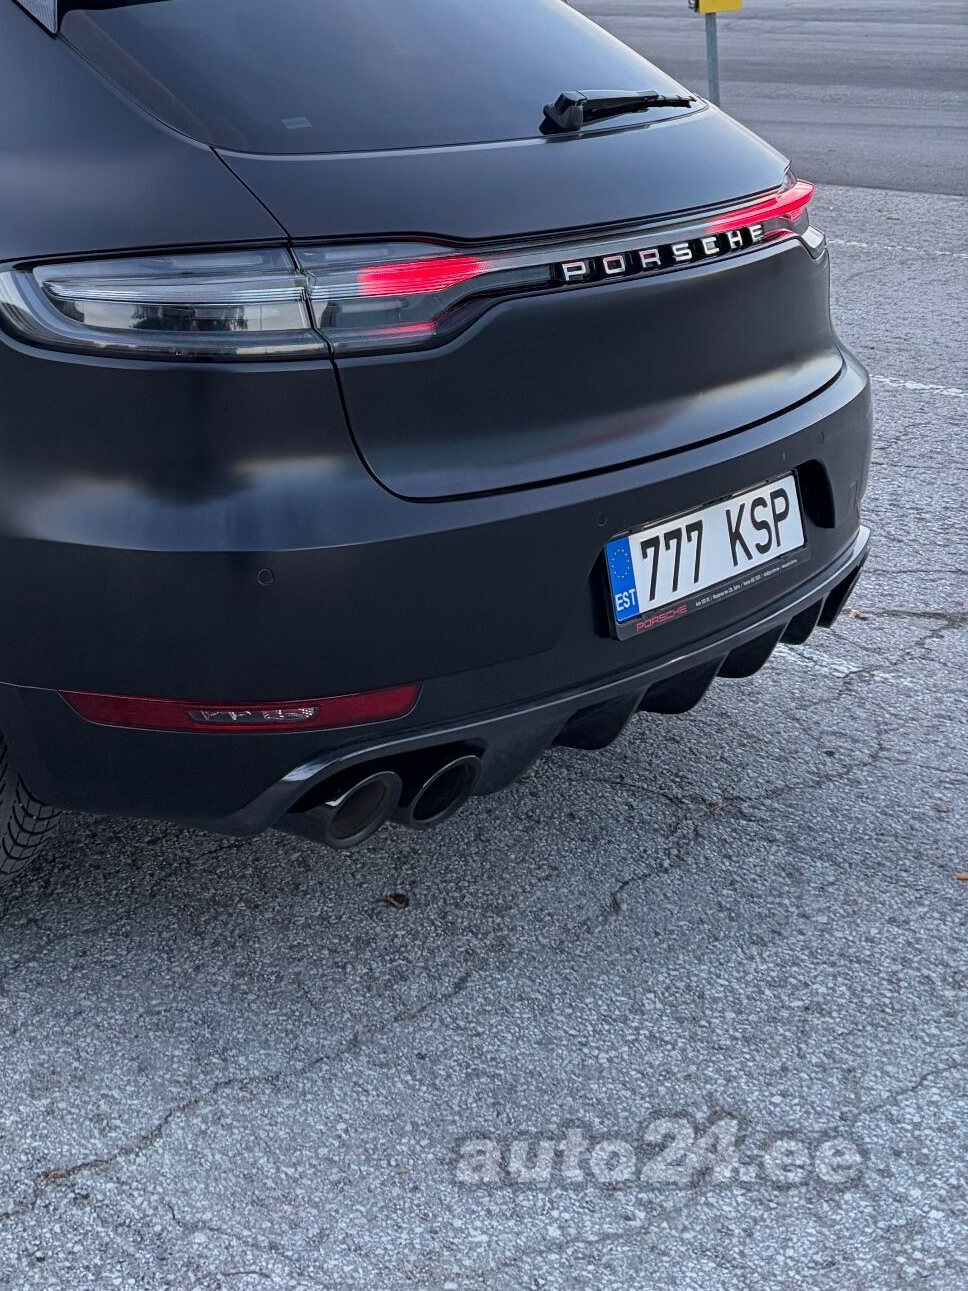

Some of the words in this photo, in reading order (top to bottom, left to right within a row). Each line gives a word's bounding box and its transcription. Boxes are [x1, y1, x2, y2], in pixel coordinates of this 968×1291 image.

[561, 224, 765, 282] PORSCHE
[639, 519, 704, 602] 777
[725, 487, 790, 567] KSP
[614, 588, 636, 612] EST
[636, 604, 688, 632] PORSCHE
